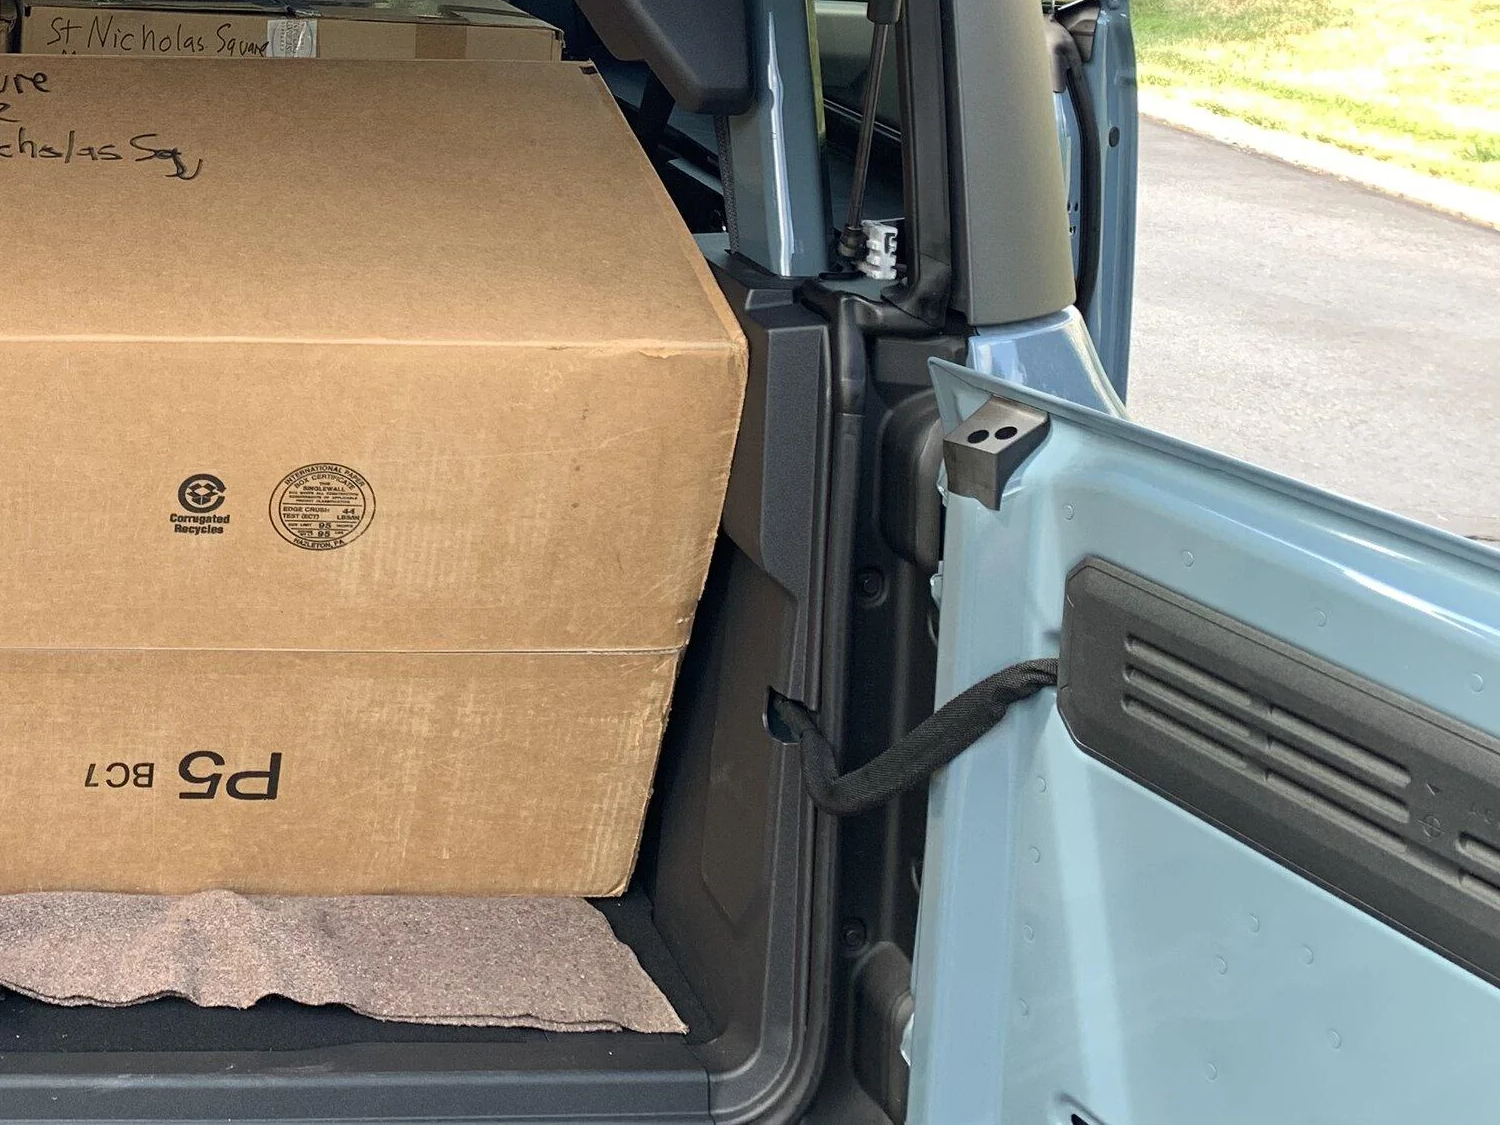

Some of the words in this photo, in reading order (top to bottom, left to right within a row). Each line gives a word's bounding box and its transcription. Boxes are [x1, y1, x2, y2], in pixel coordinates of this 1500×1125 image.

[47, 17, 82, 46] St
[87, 15, 205, 53] Nicholas
[216, 23, 270, 57] Square
[284, 465, 342, 486] INTERNATIONAL
[344, 469, 365, 487] PAPER
[293, 477, 310, 489] BOX
[311, 473, 356, 490] CERTIFICATE
[169, 513, 230, 525] Corrugated
[174, 524, 224, 535] Recycles
[293, 537, 333, 549] HAZLETON,
[84, 762, 155, 788] BC7
[178, 750, 282, 801] P5
